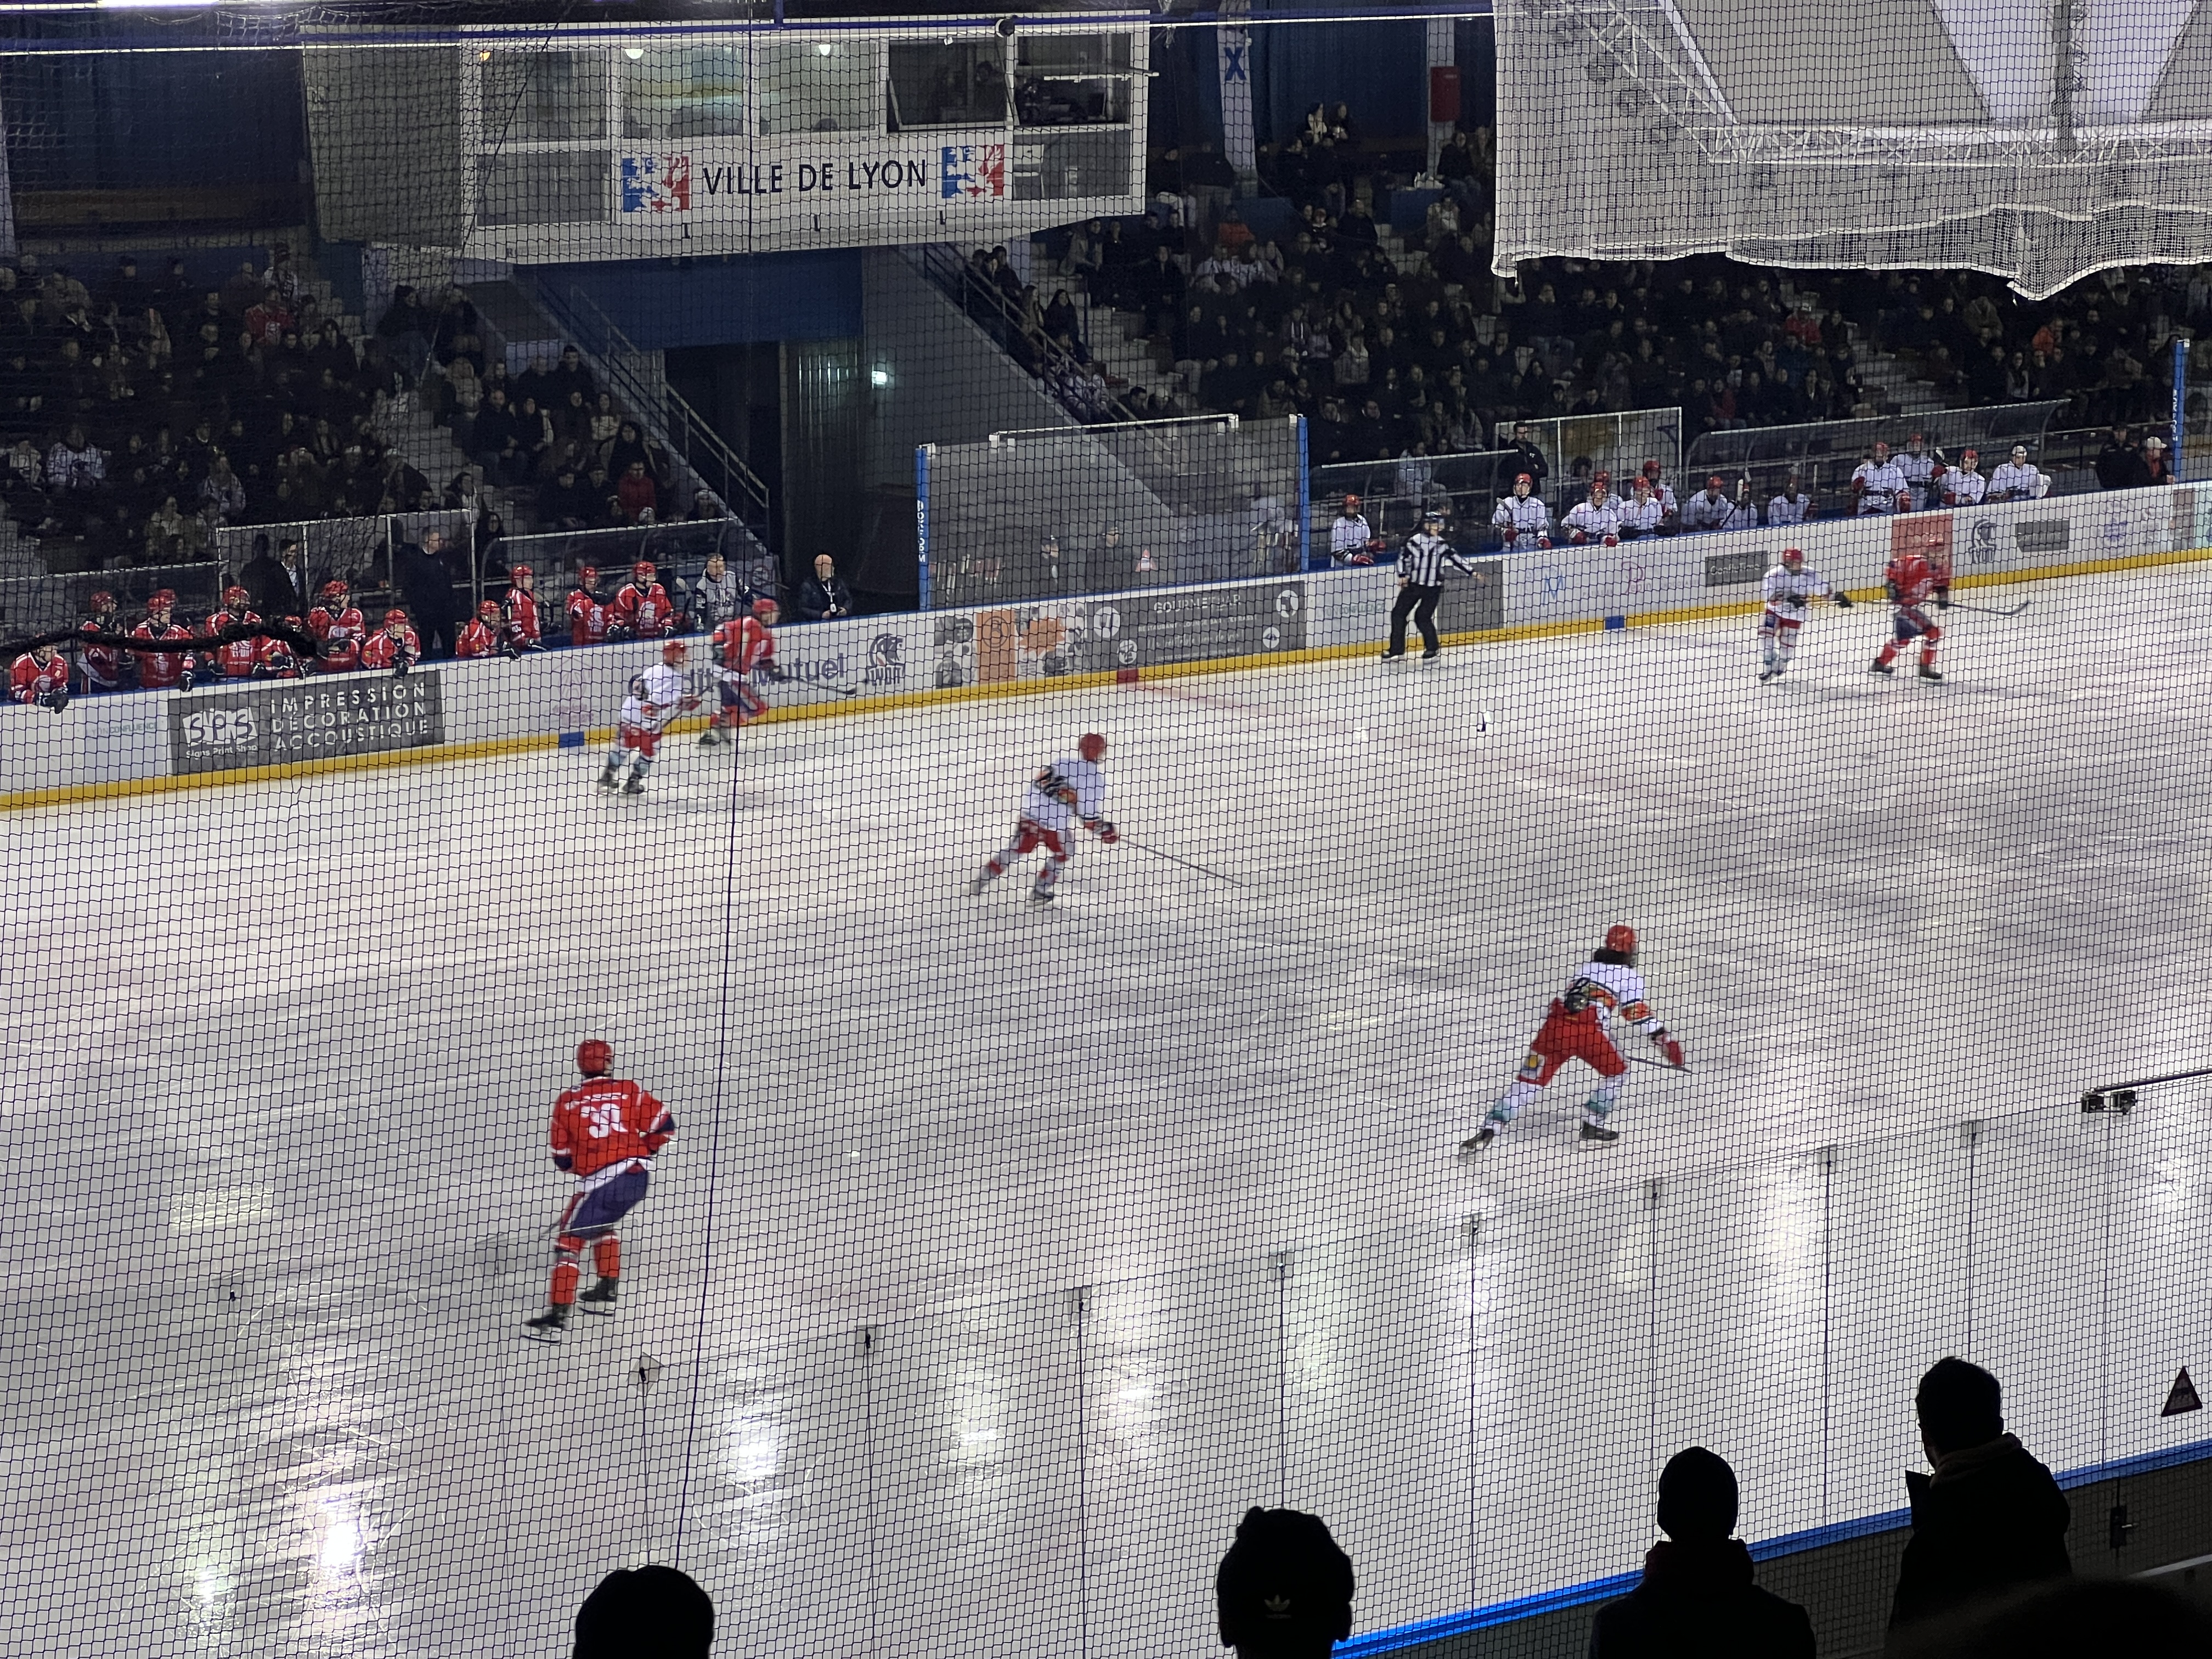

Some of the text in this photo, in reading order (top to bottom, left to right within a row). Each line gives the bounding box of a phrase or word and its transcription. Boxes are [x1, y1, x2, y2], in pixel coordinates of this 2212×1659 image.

[703, 159, 927, 195] VILLE DE LYON
[628, 668, 713, 695] Cdit
[271, 682, 425, 714] IMPRESSION
[274, 719, 428, 752] ACCOUSTIQUE
[186, 750, 210, 760] Signs
[213, 746, 233, 755] Print
